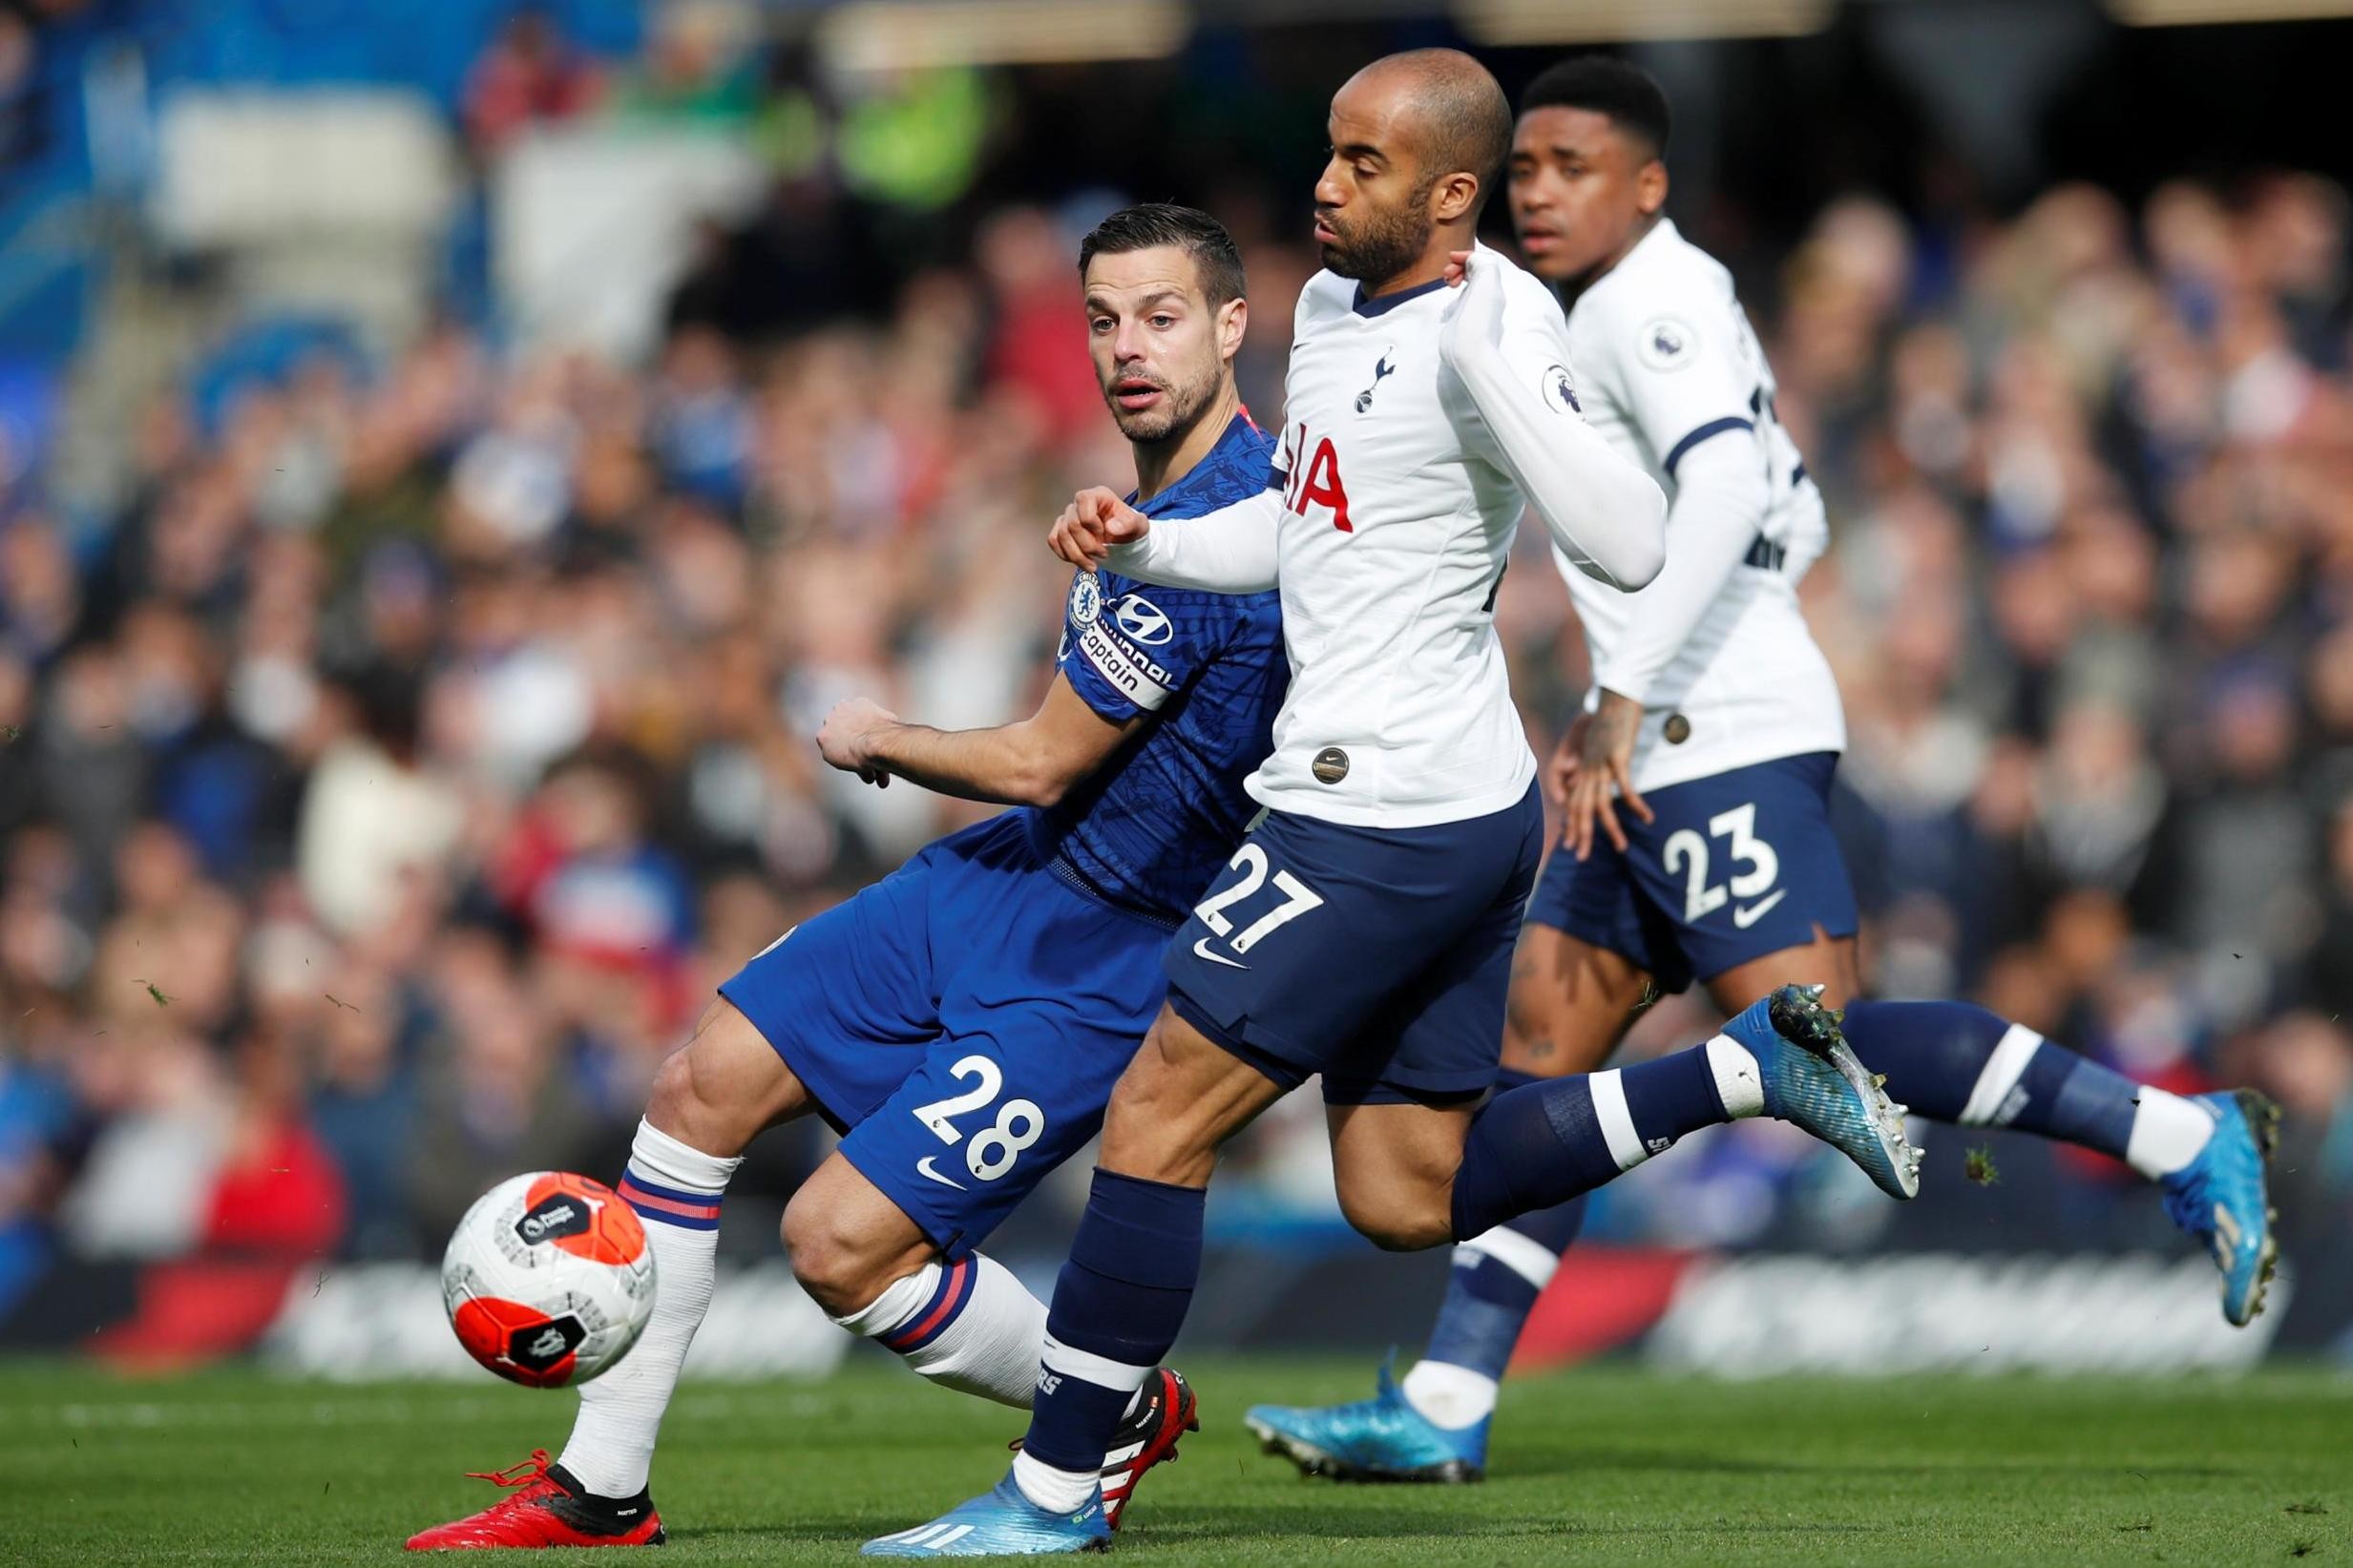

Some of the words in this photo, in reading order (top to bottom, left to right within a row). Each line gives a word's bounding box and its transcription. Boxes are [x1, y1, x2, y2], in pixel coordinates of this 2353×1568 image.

[1194, 843, 1324, 954] 27
[1663, 803, 1778, 923] 23
[912, 1055, 1045, 1181] 28
